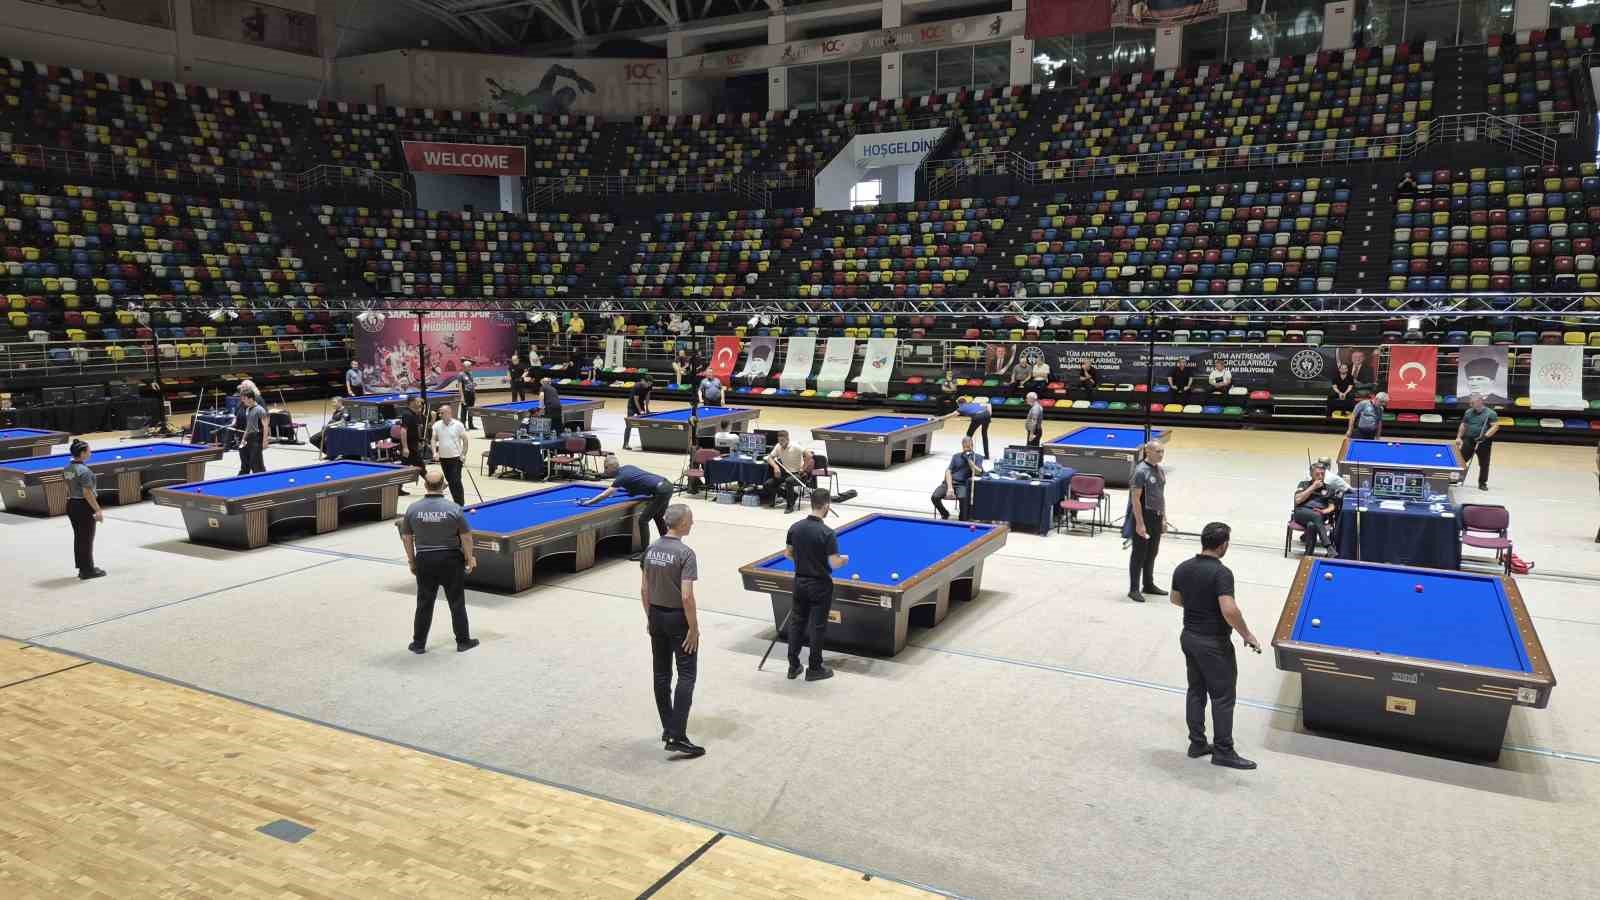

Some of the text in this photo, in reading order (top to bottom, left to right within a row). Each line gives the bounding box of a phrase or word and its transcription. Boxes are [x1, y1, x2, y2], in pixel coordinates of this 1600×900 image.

[863, 134, 938, 158] HOŞGELDİNİ
[424, 151, 509, 169] WELCOME
[1081, 350, 1116, 358] ANTRENÖR
[1213, 351, 1270, 360] TÜM ANTRENÖR
[416, 511, 449, 519] HAKEM
[647, 550, 674, 563] HAKEM
